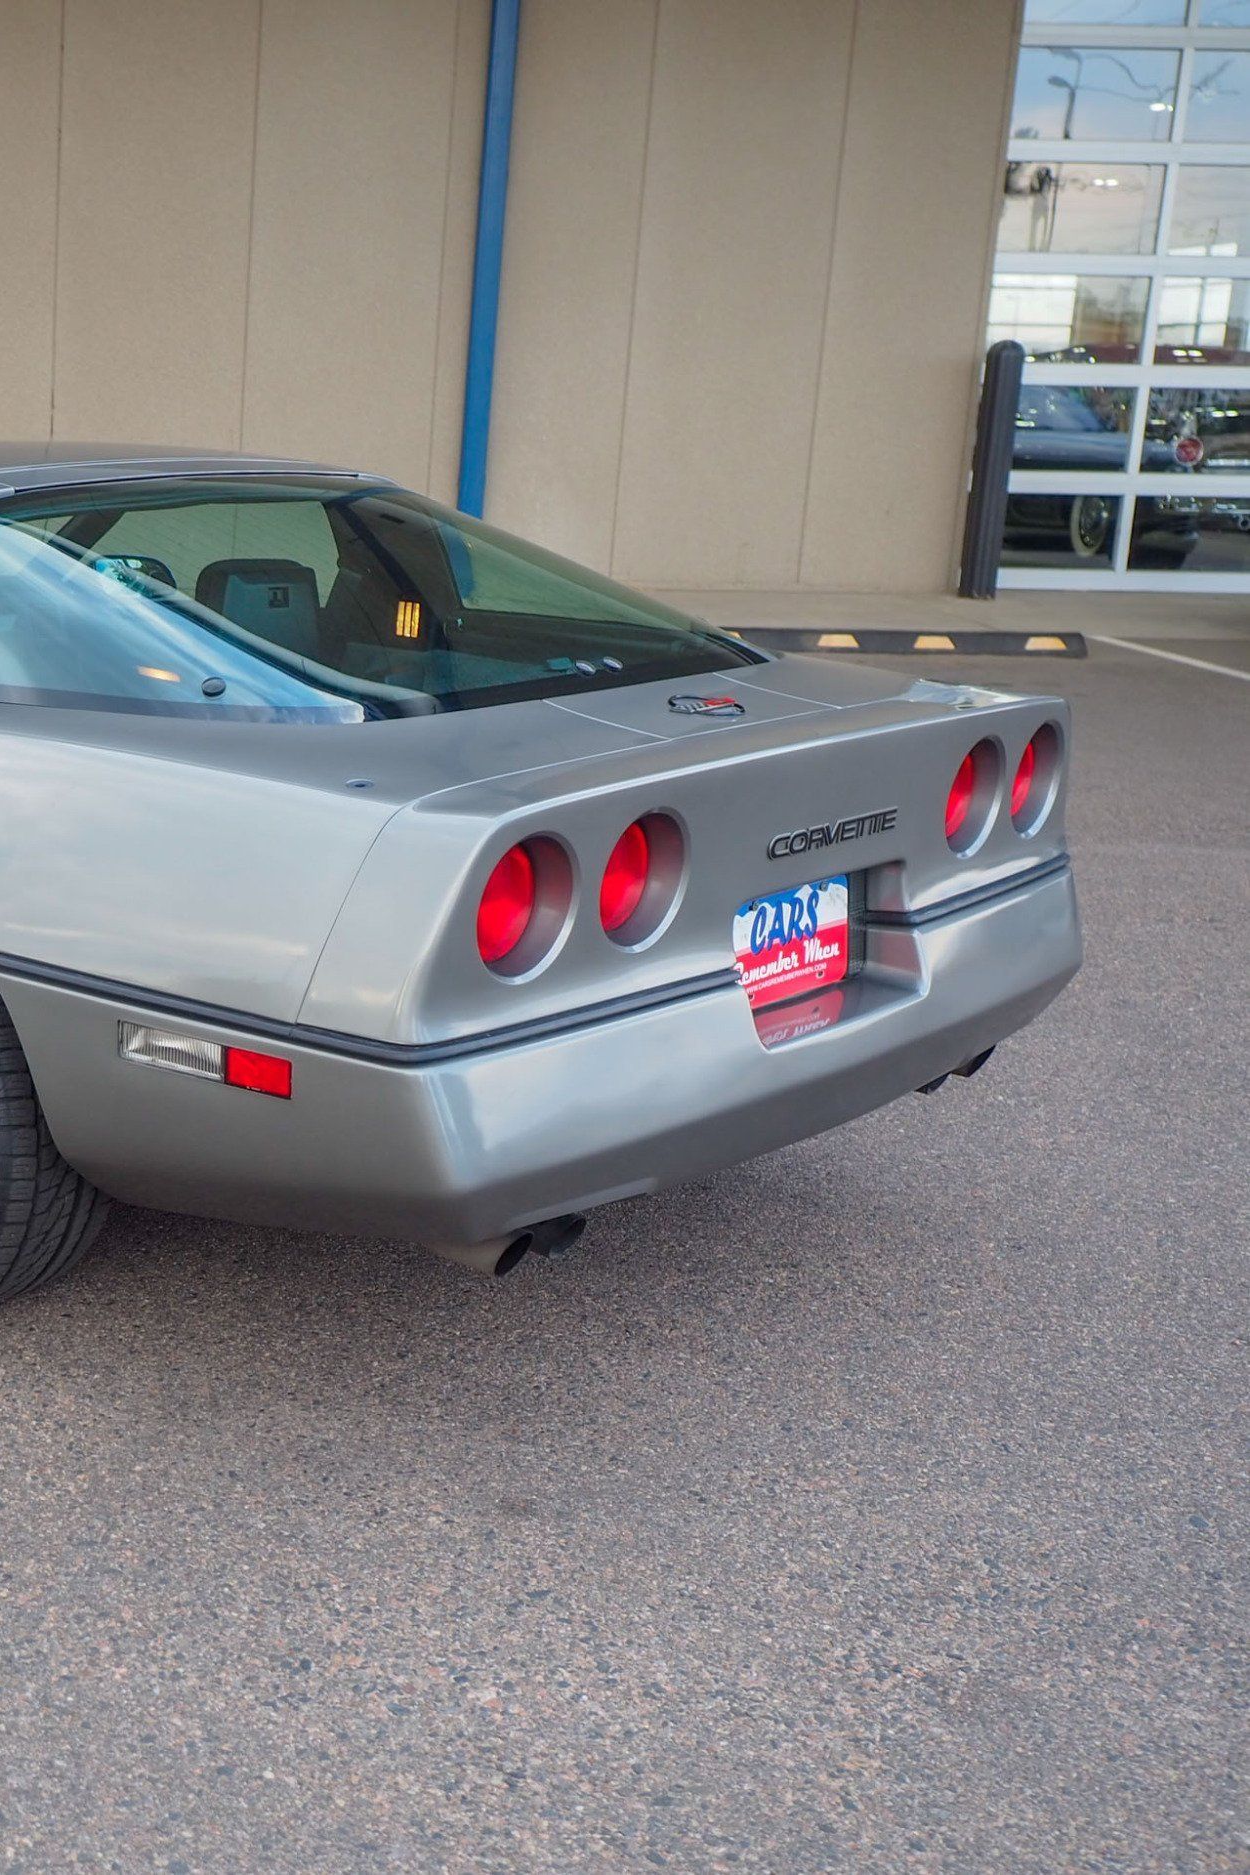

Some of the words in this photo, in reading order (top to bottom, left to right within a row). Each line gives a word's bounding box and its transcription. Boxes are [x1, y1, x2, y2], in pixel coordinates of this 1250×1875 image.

[767, 806, 898, 860] CORVETTE
[750, 890, 819, 955] CARS
[734, 951, 799, 986] Remember
[803, 937, 840, 964] When
